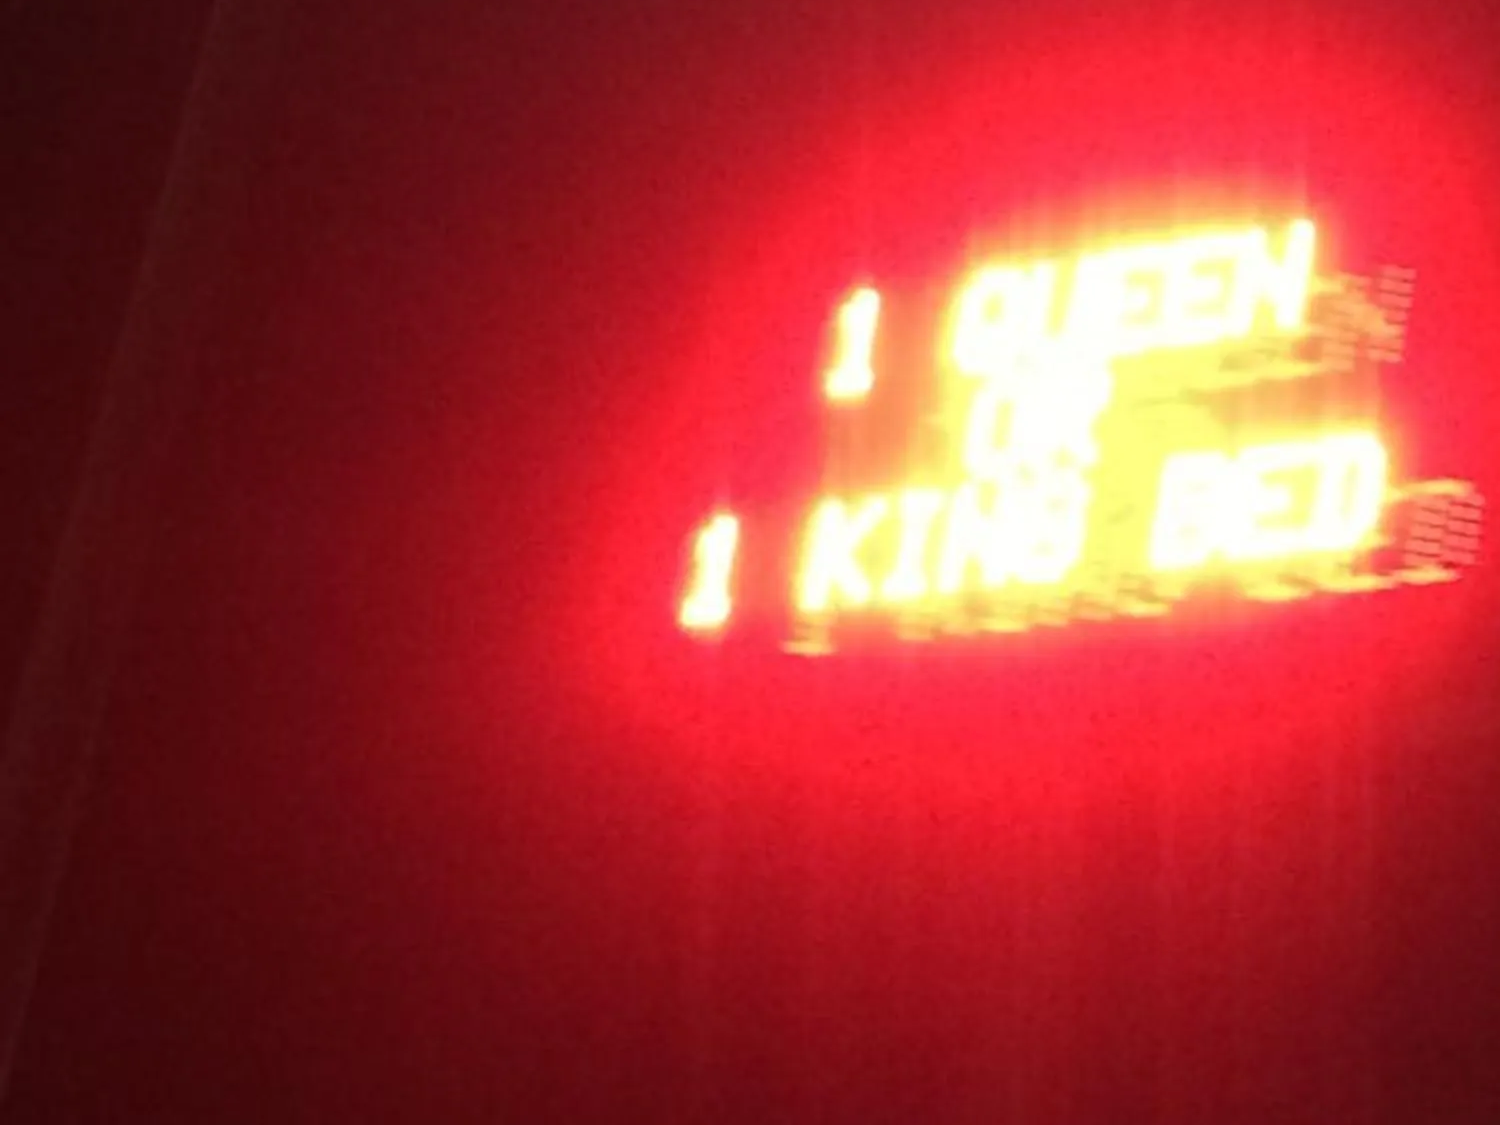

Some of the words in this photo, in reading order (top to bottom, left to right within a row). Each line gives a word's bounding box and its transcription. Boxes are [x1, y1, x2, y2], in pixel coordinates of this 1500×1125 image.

[827, 287, 880, 395] 1
[951, 218, 1317, 377] QUEEN
[682, 514, 738, 625] 1
[802, 471, 1089, 609] KING
[1150, 432, 1386, 571] BED
